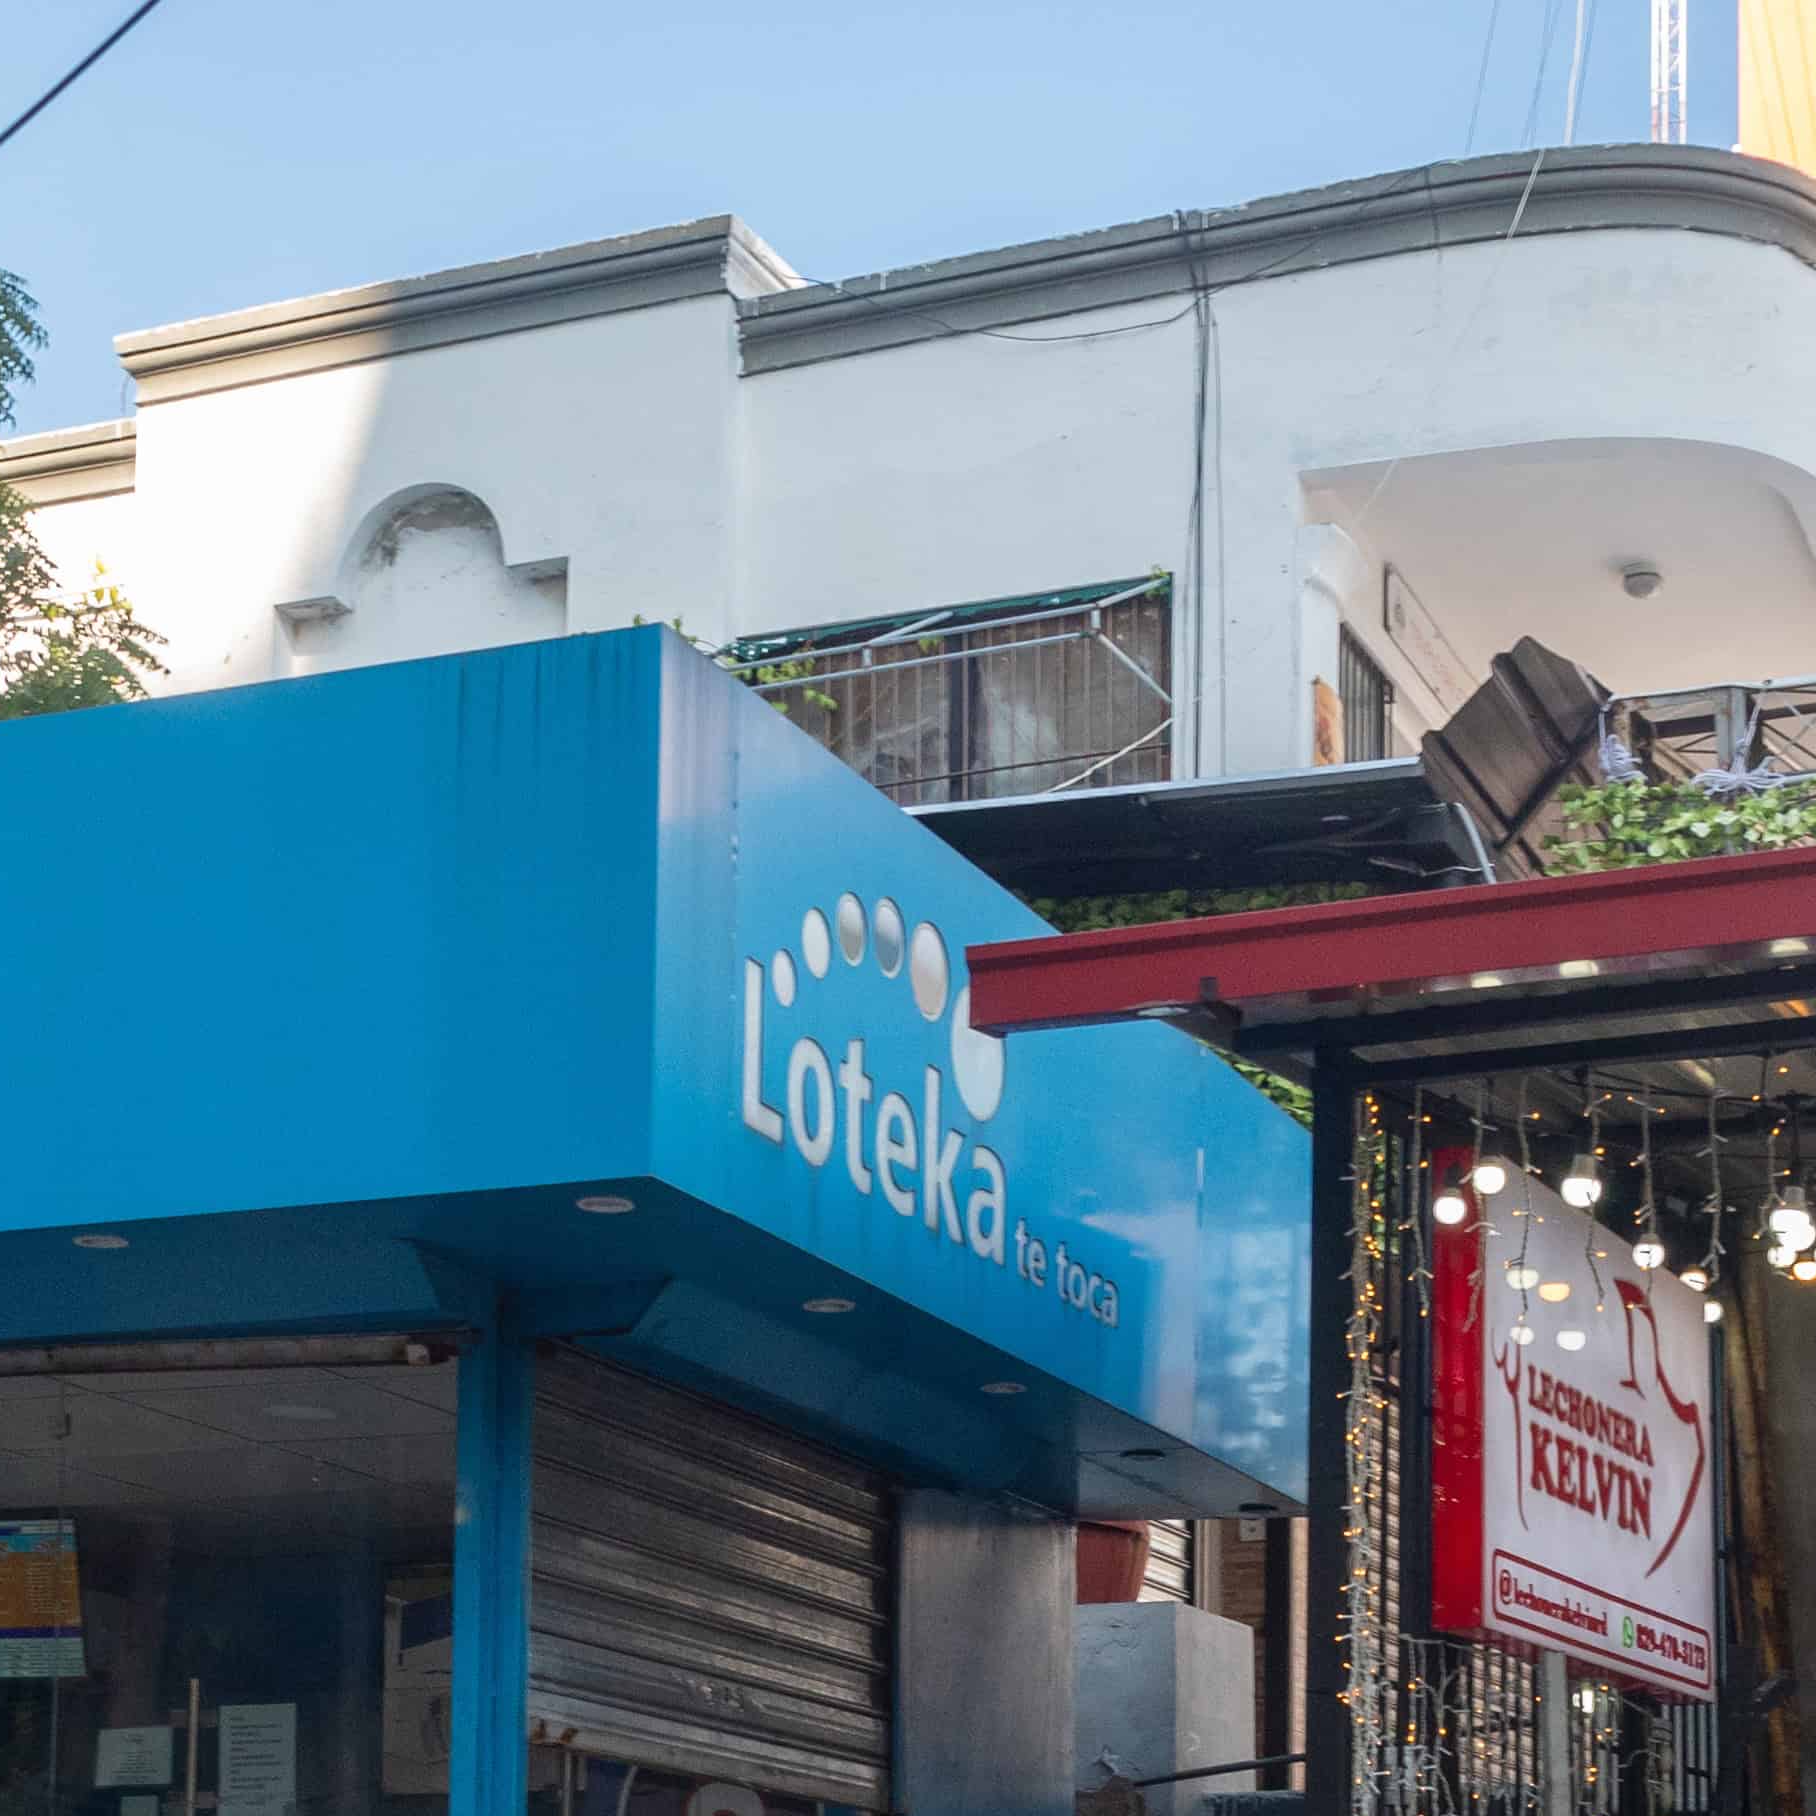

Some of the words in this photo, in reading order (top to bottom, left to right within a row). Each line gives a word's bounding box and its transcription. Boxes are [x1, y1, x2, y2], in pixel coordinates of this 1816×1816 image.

[742, 957, 1007, 1267] Loteka
[1016, 1218, 1046, 1287] te
[1056, 1240, 1120, 1329] toca
[1528, 1364, 1654, 1467] LECHONERA
[1530, 1423, 1652, 1540] KELVIN
